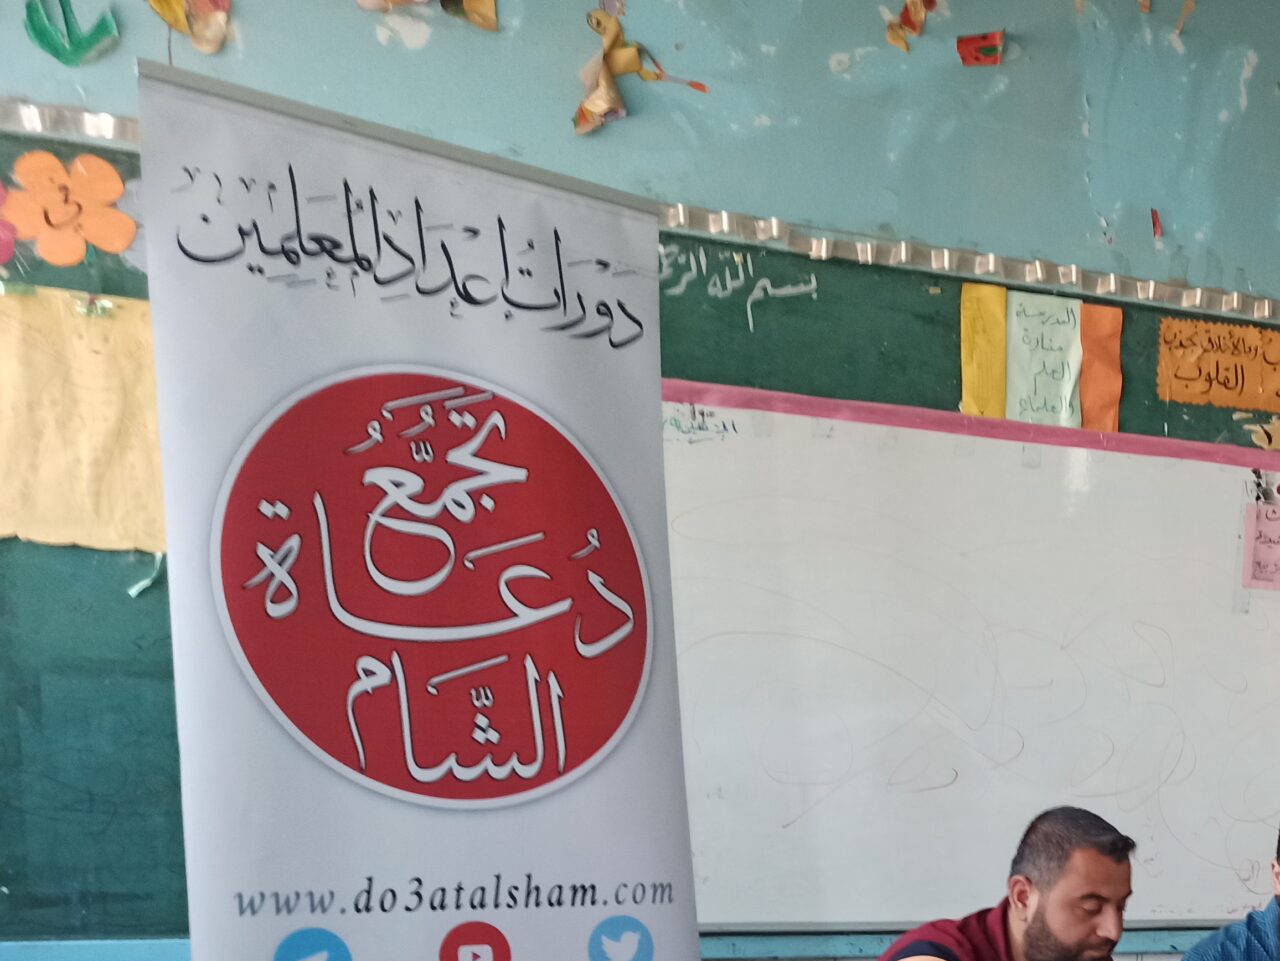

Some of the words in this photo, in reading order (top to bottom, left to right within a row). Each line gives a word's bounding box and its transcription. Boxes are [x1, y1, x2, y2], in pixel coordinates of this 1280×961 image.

[707, 252, 753, 298] الله
[747, 272, 818, 333] بسم
[1016, 303, 1076, 330] المدرسة
[1022, 328, 1063, 352] منارة
[1034, 360, 1072, 396] العلم
[1174, 360, 1246, 396] القلوب
[234, 873, 675, 918] www.do3atalsham.com
